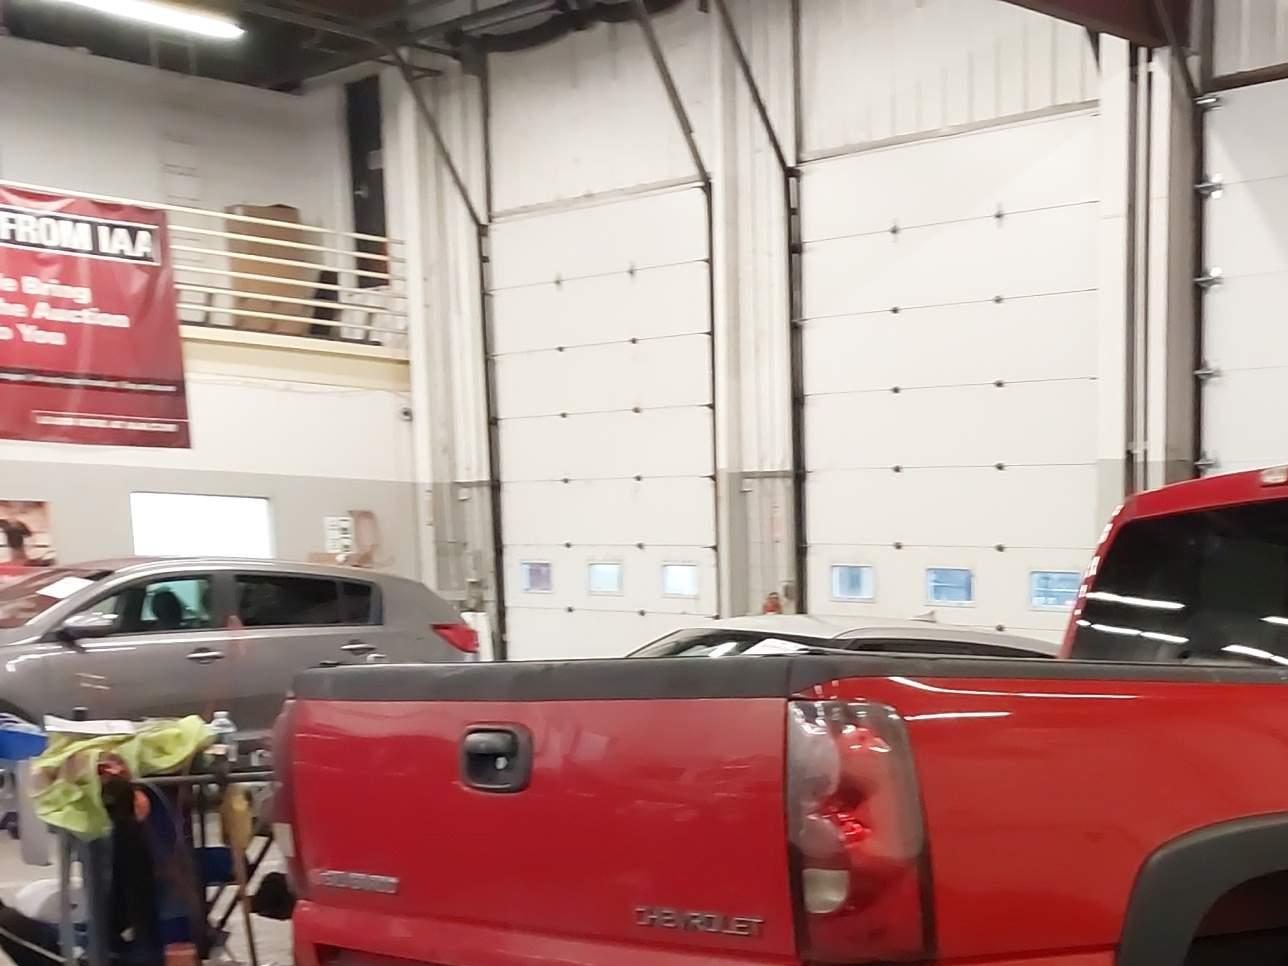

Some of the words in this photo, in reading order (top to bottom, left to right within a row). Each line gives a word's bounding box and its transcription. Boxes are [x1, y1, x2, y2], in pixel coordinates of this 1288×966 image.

[0, 211, 93, 251] FROM
[97, 225, 153, 257] IAA
[21, 276, 92, 304] Bring
[31, 302, 130, 328] Auction
[15, 323, 66, 345] You
[634, 907, 764, 936] CHEVROLET
